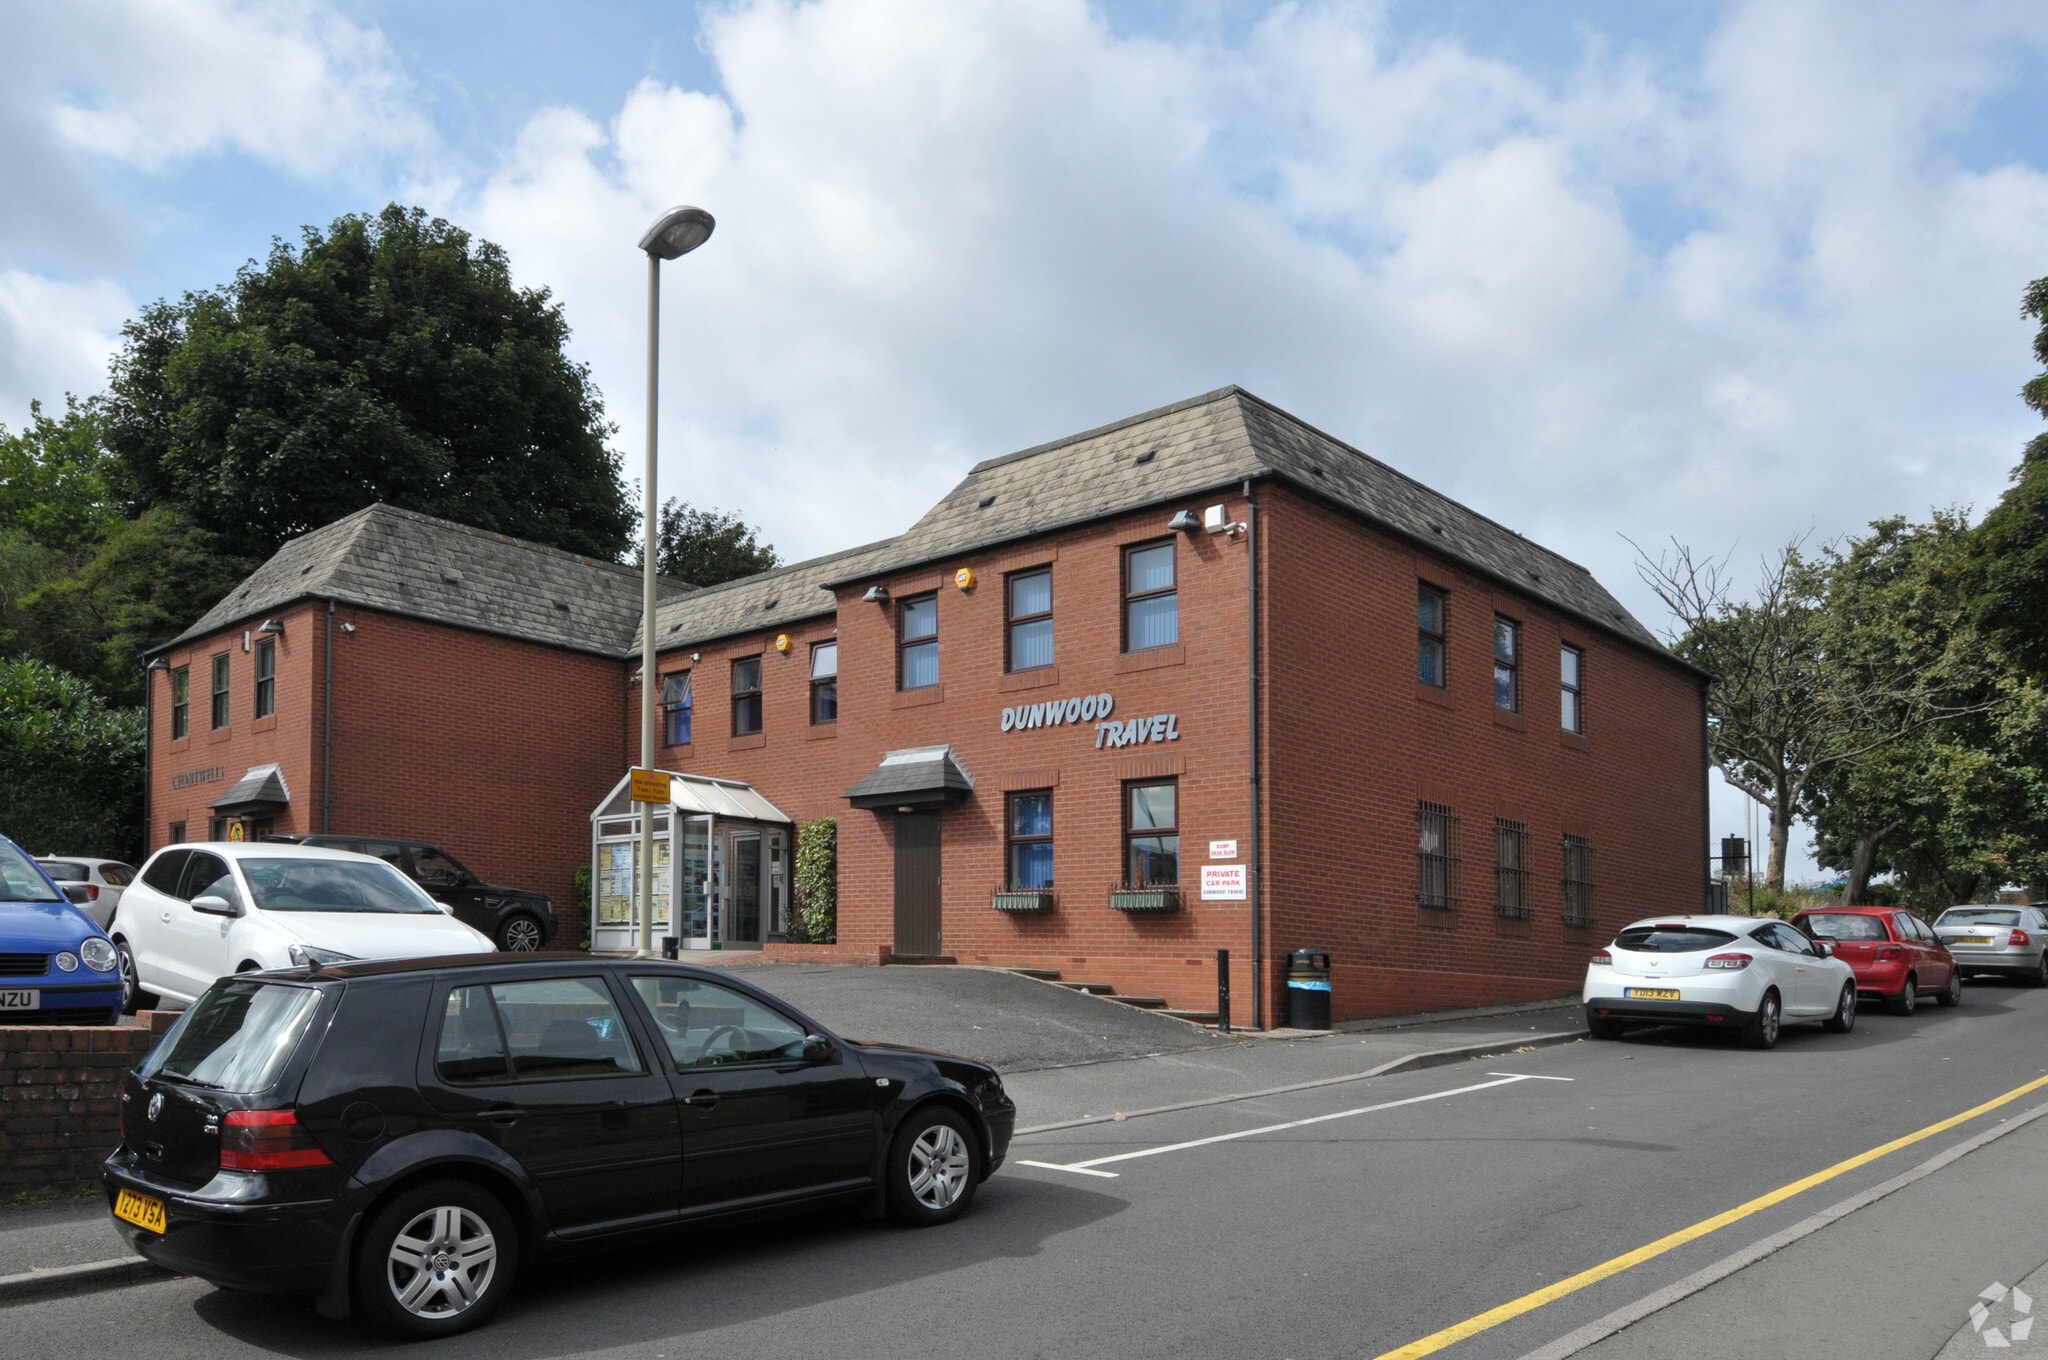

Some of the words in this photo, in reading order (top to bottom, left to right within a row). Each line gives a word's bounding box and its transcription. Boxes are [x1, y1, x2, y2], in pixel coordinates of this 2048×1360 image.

[1000, 692, 1114, 732] DUNWOOD
[1095, 714, 1180, 749] TRAVEL
[172, 766, 224, 790] CHARTWELLS
[120, 1188, 143, 1218] Y273
[142, 1199, 163, 1227] VSA
